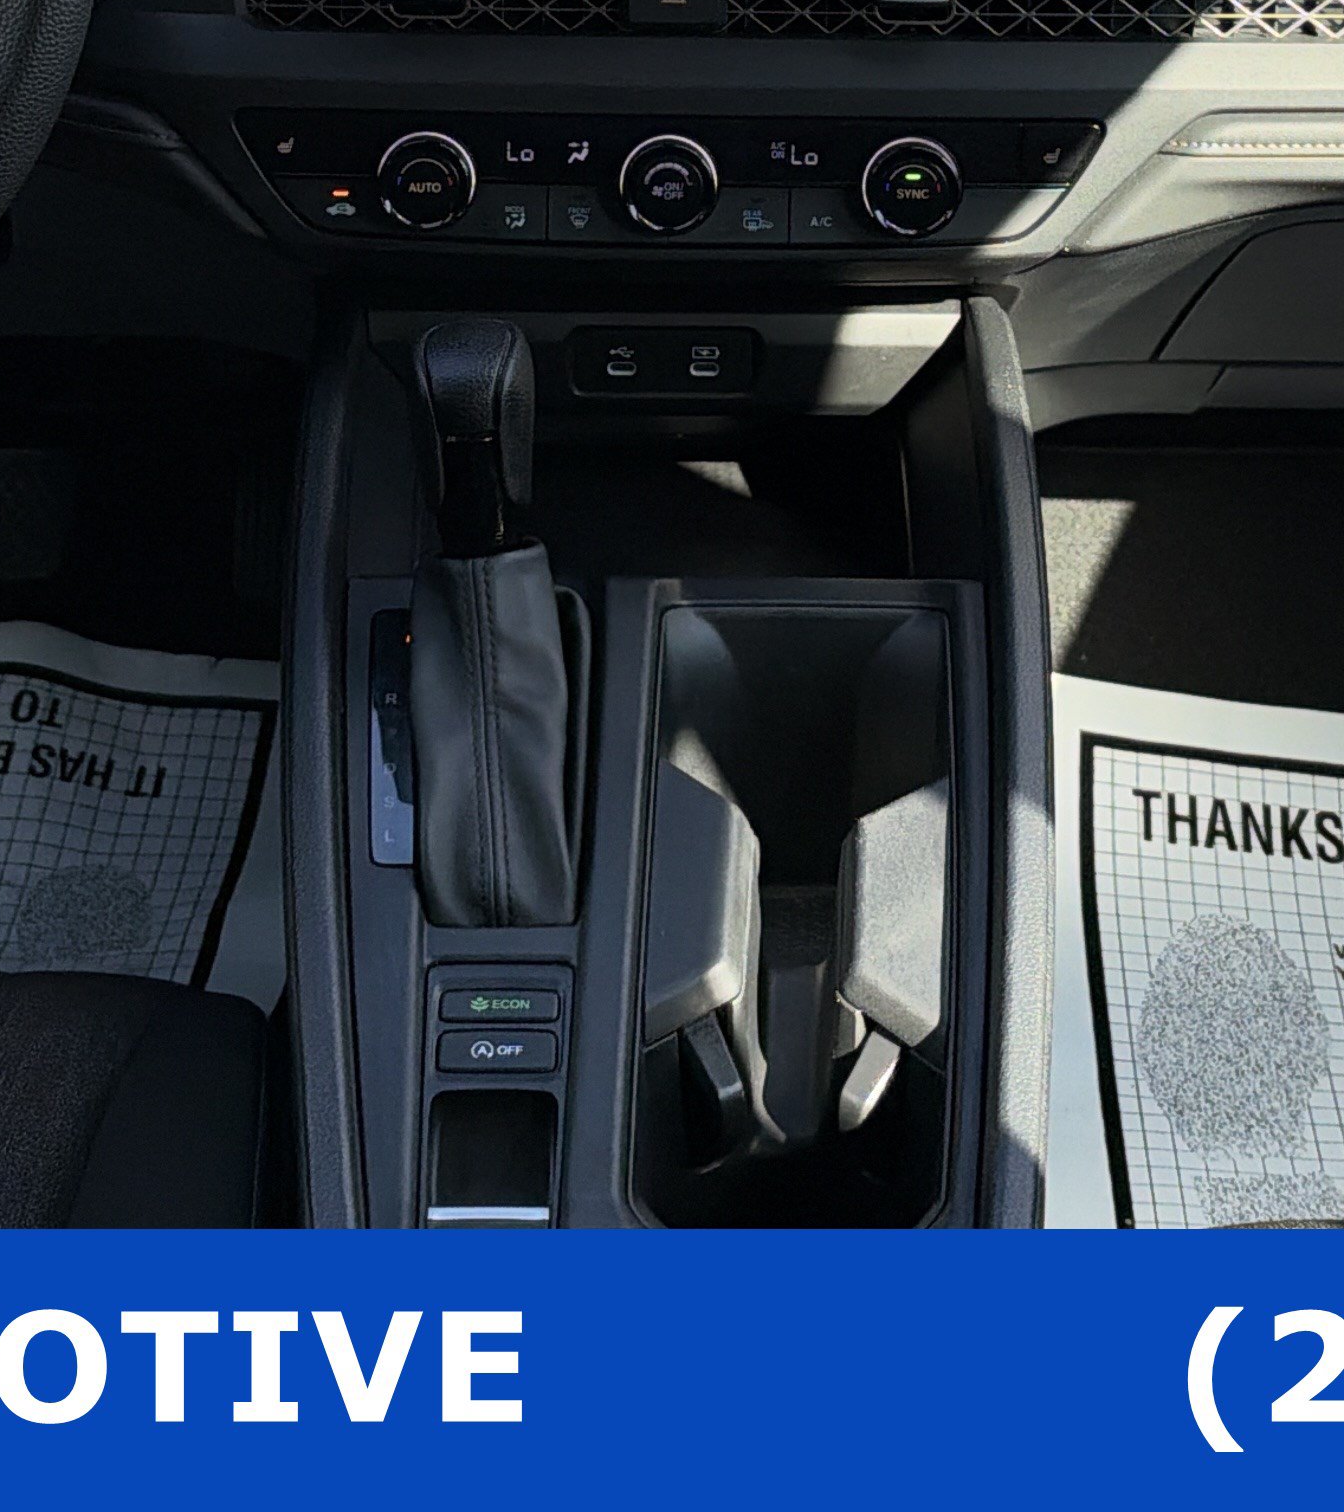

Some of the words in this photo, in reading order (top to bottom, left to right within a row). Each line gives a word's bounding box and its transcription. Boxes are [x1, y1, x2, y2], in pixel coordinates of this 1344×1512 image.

[506, 141, 535, 163] Lo
[791, 143, 819, 166] Lo
[408, 182, 442, 194] AUTO
[896, 188, 930, 200] SYNC
[664, 191, 684, 200] OFF
[809, 217, 834, 228] A/C
[385, 692, 397, 705] R
[11, 689, 63, 728] TO
[29, 742, 113, 786] HAS
[124, 766, 166, 799] IT
[385, 829, 395, 843] L
[492, 999, 531, 1010] ECON
[497, 1045, 524, 1056] OFF
